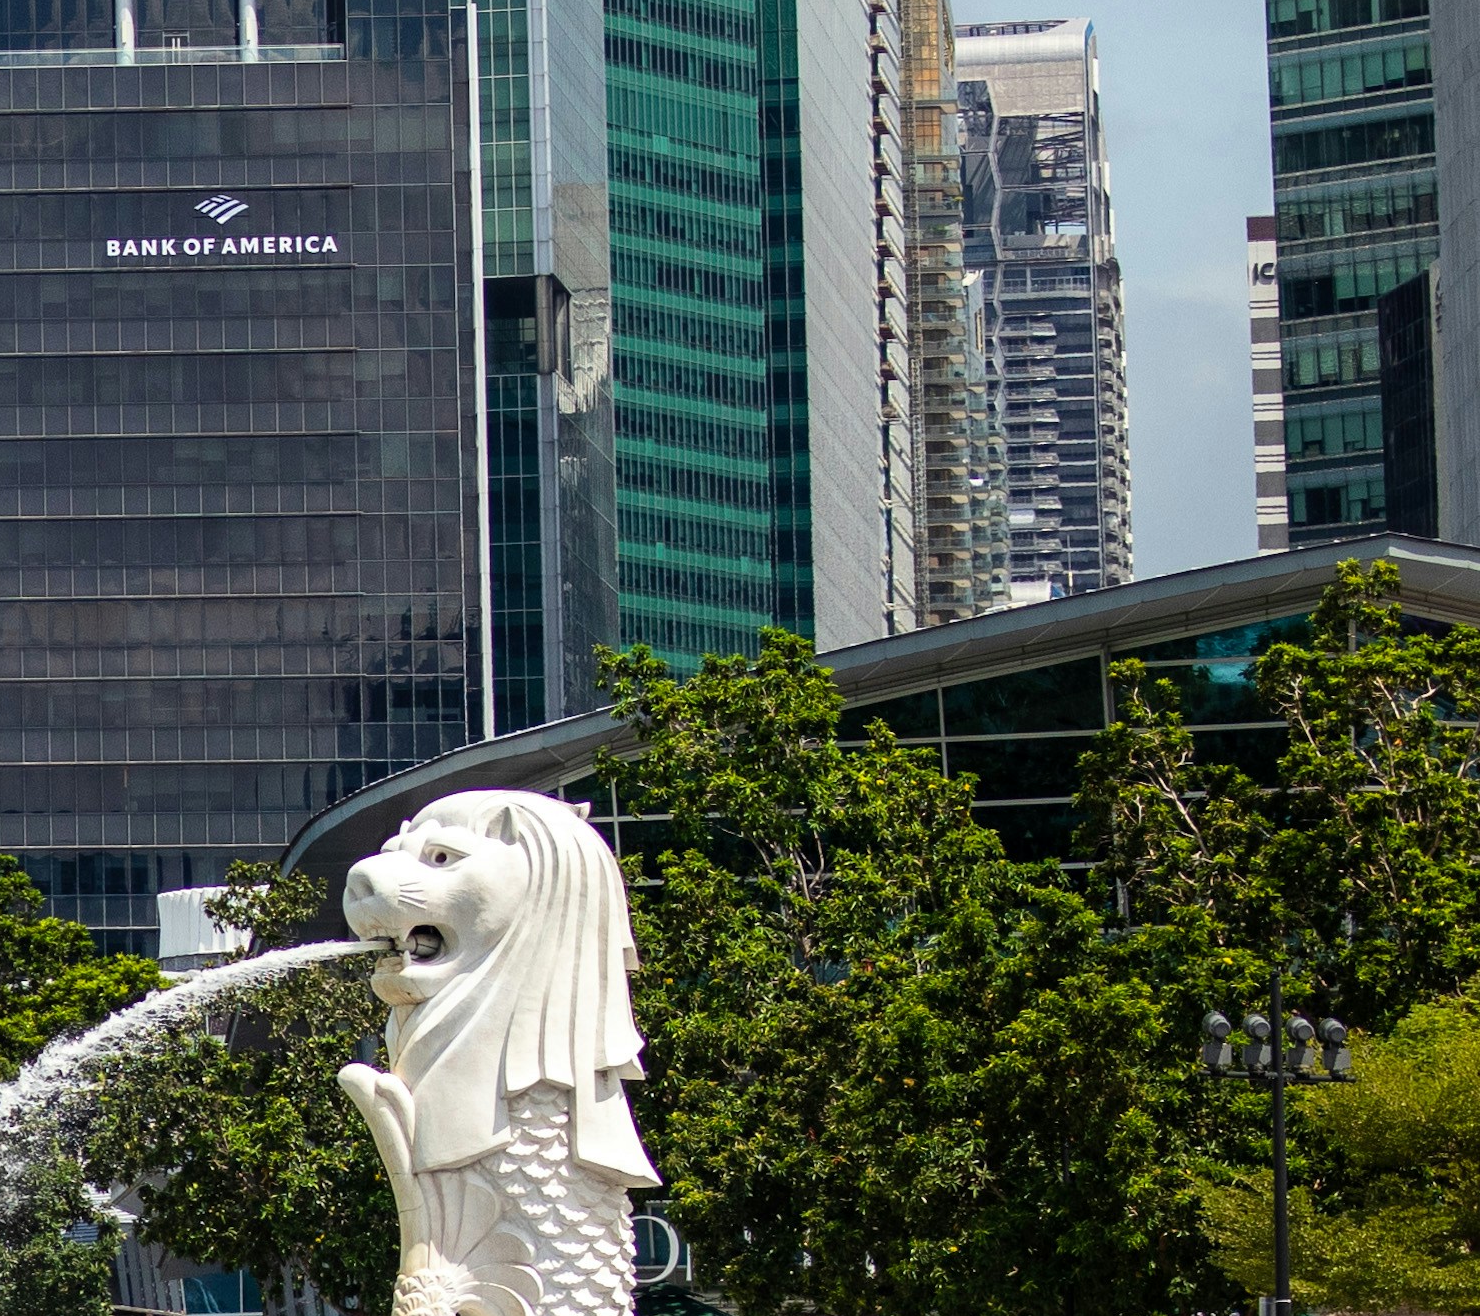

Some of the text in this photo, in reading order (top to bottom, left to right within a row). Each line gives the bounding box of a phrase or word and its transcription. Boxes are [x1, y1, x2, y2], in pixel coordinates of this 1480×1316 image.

[106, 235, 339, 257] BANK OF AMERICA
